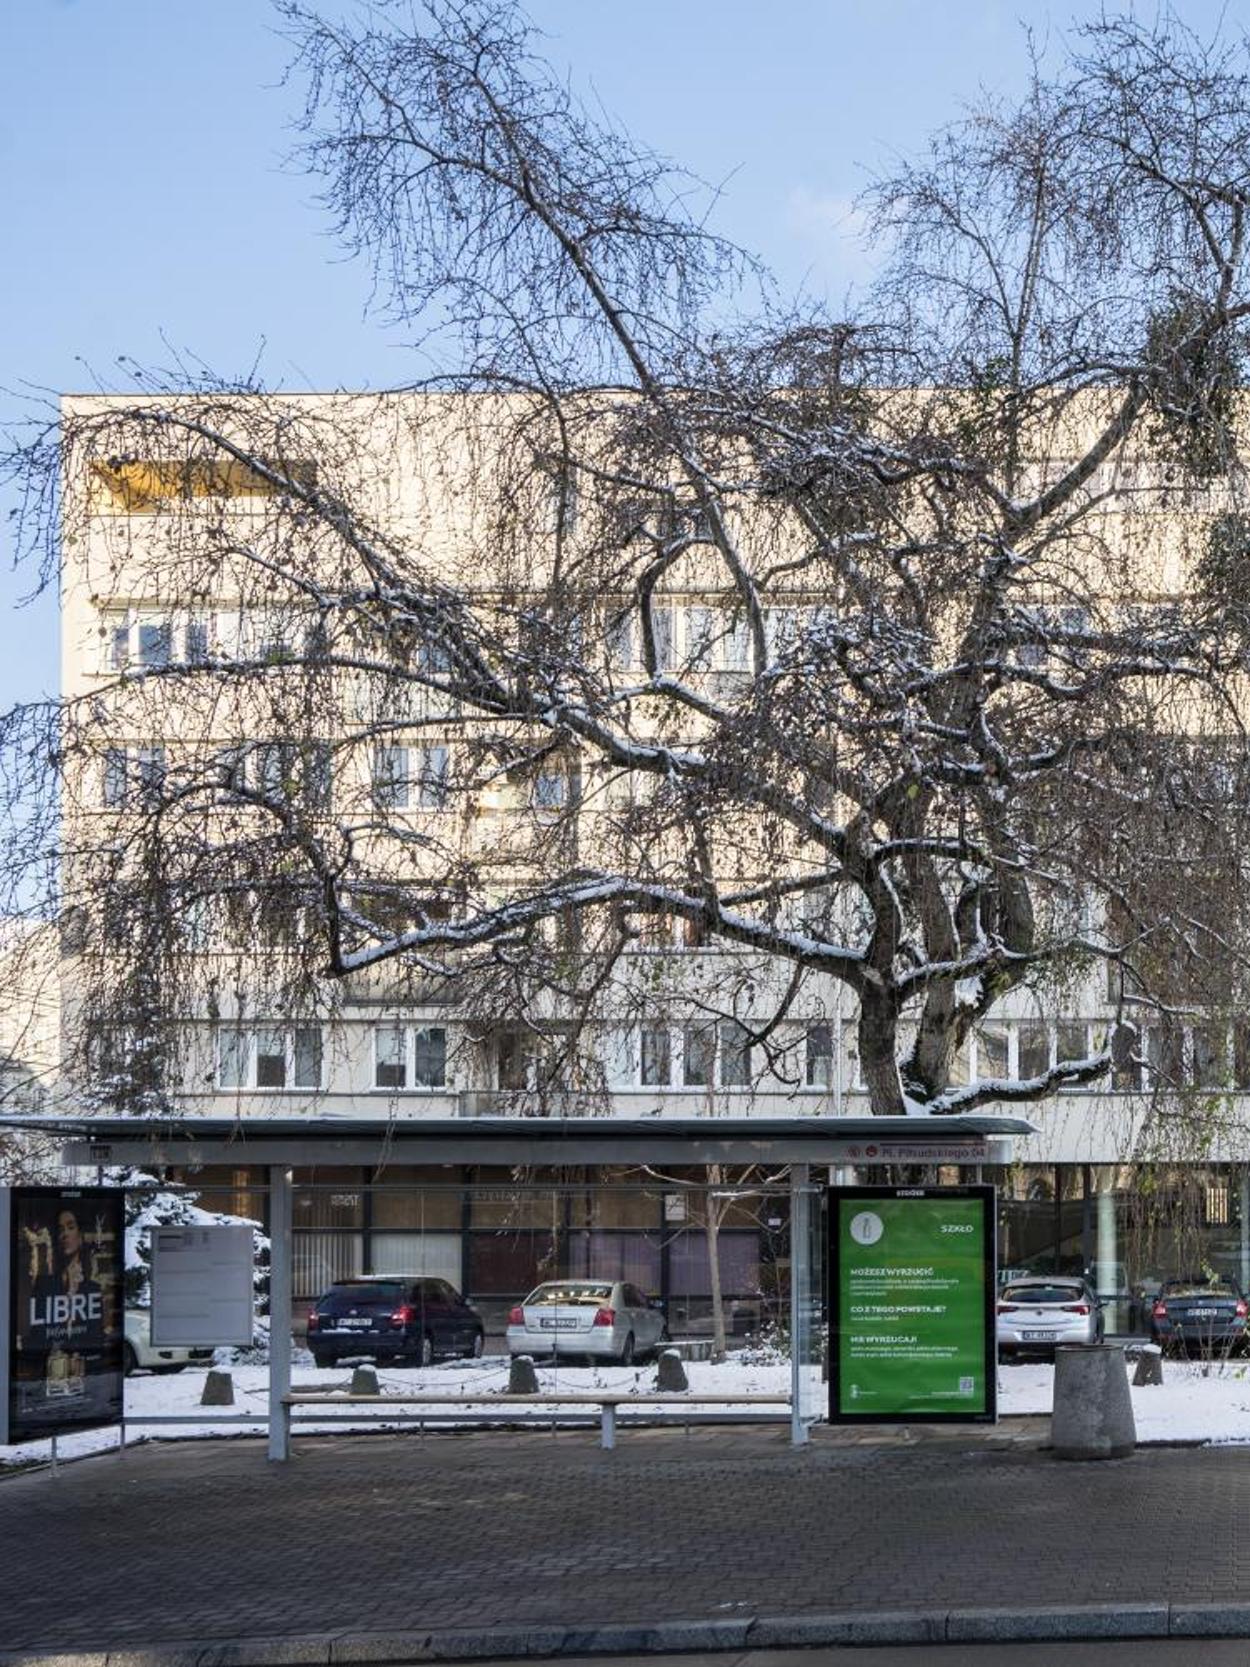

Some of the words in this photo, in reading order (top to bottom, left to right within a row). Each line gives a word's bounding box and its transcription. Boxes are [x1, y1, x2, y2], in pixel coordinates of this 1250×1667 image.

[941, 1224, 974, 1233] SZKŁO
[30, 1292, 102, 1326] LIBRE
[896, 1305, 947, 1313] POWSTAJE?
